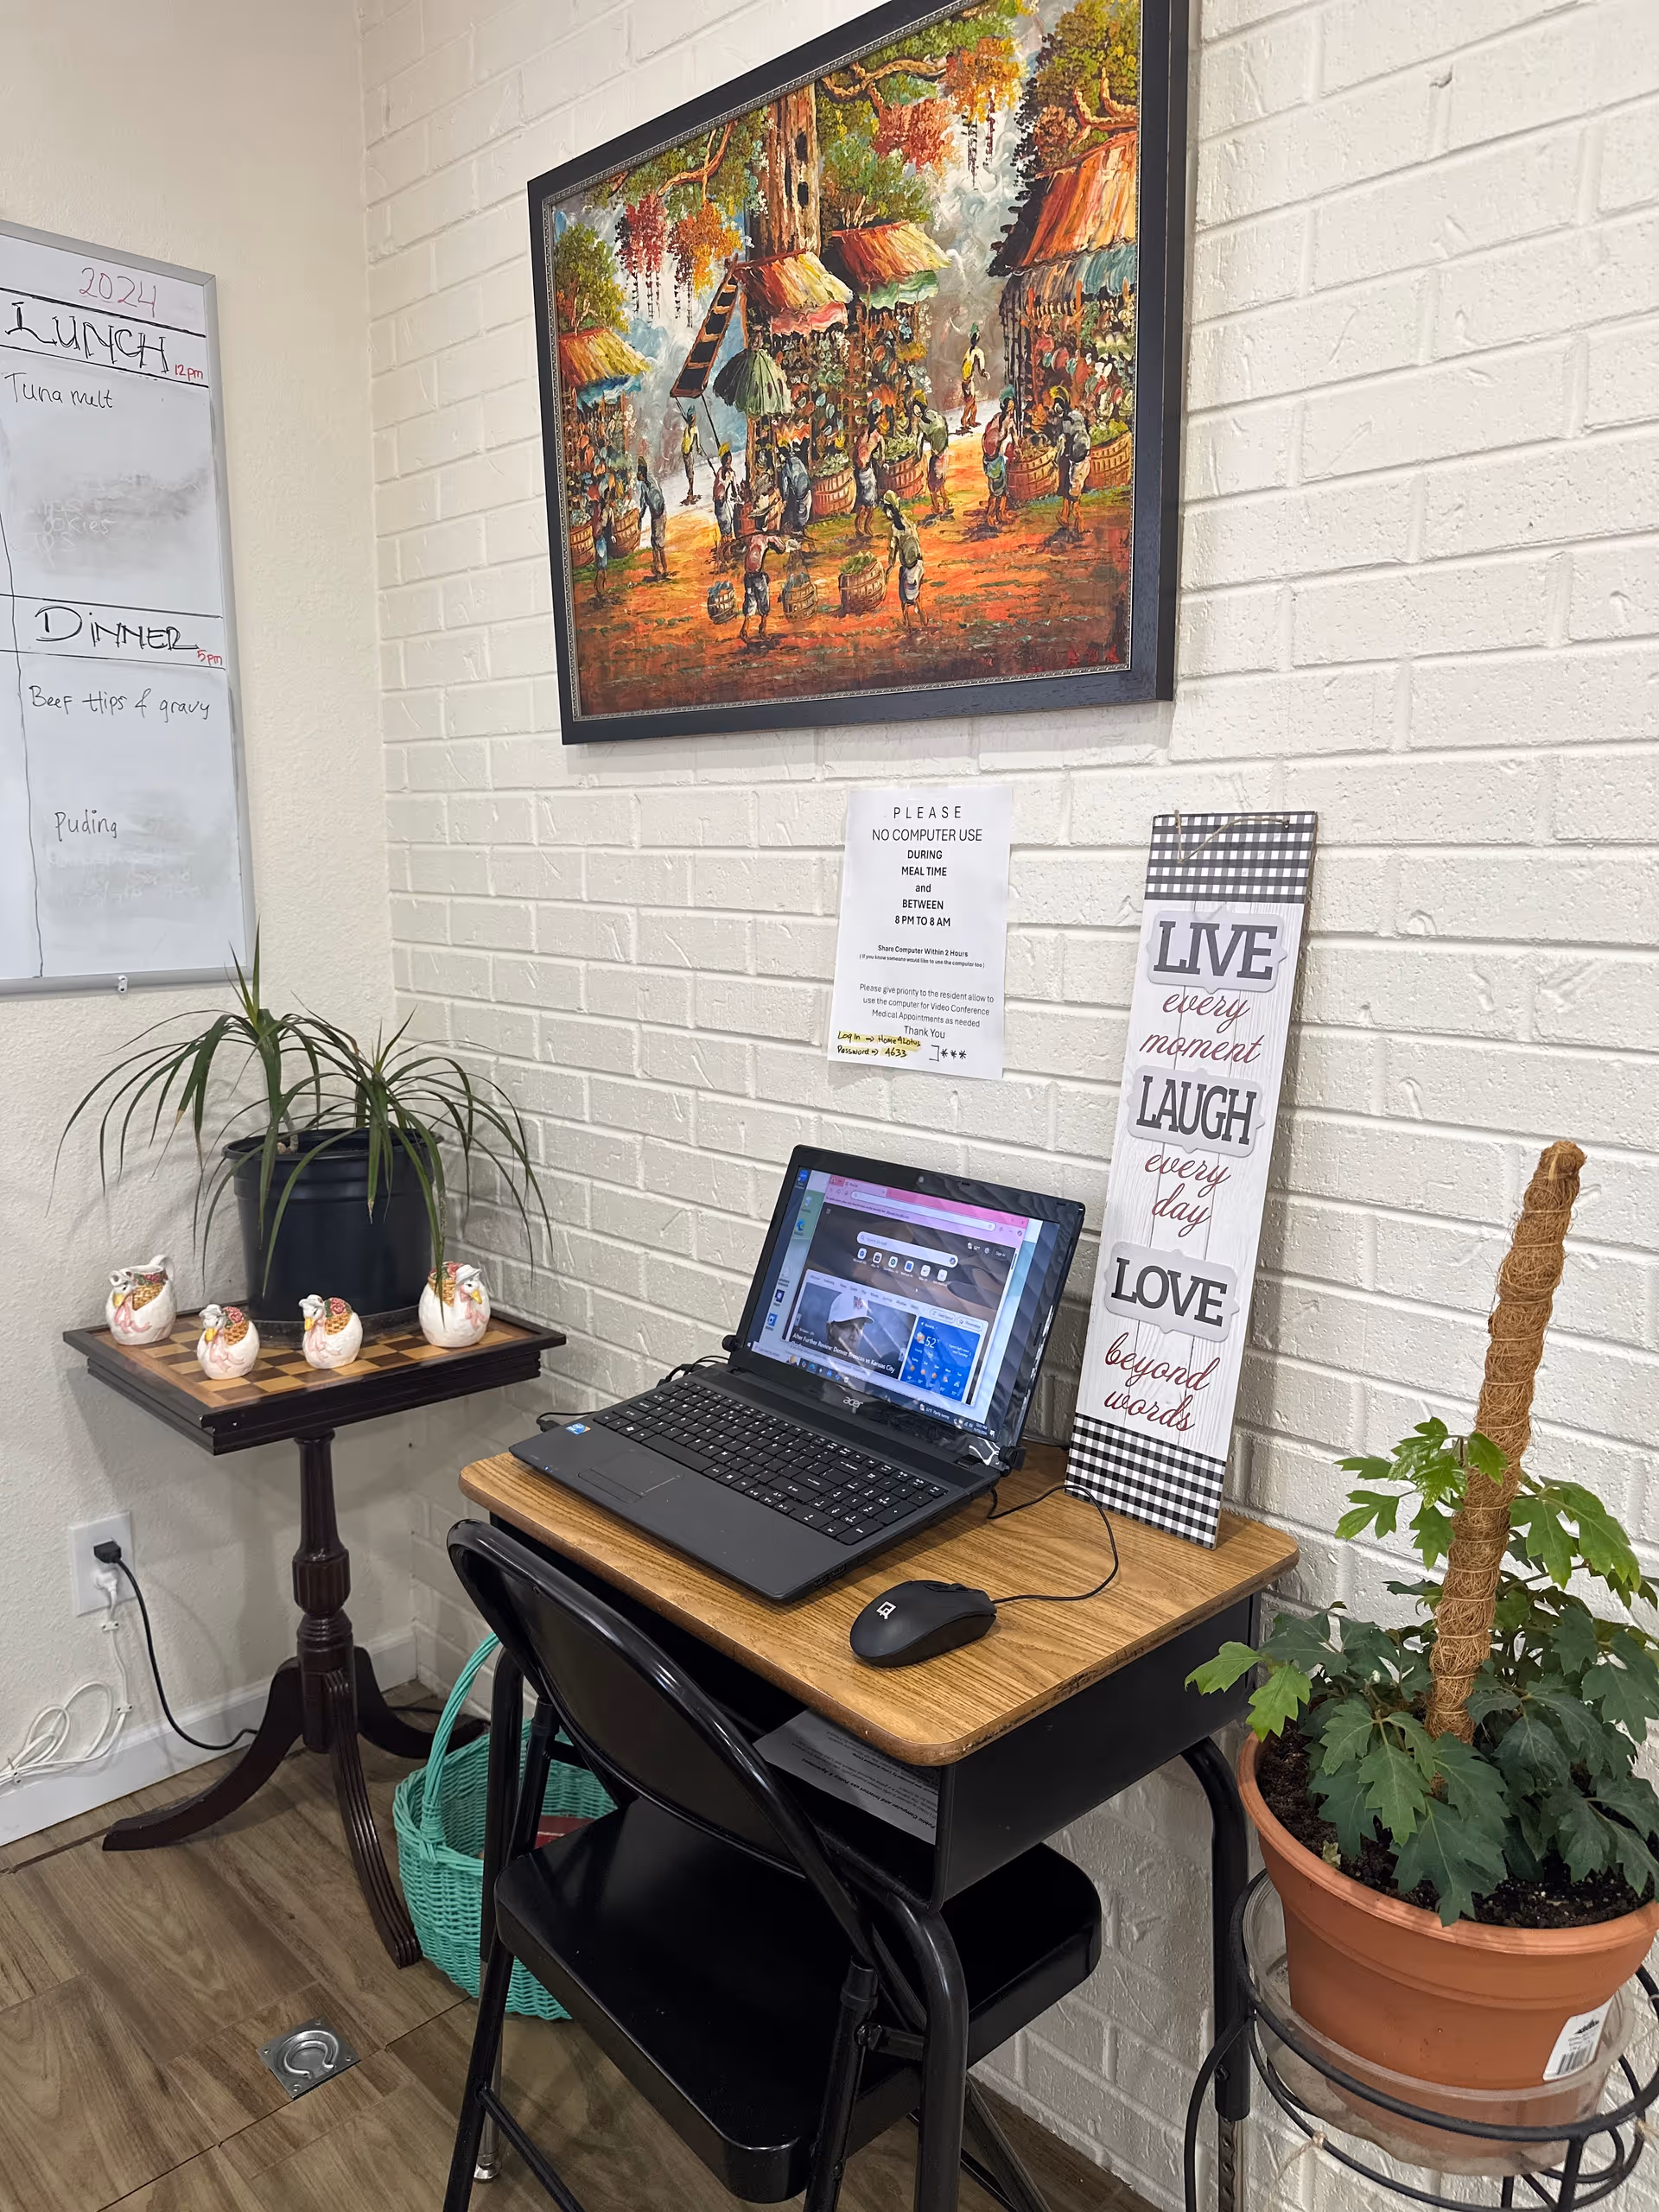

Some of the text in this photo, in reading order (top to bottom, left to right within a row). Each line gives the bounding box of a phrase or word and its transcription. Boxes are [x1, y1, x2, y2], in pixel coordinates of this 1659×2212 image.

[79, 268, 156, 317] 2024
[4, 302, 204, 382] LUNCH 12pm
[4, 372, 63, 403] Tuna
[197, 650, 224, 666] 5pm
[159, 699, 210, 723] gravy
[54, 810, 118, 842] Puding
[872, 828, 982, 842] NO COMPUTER USE
[907, 849, 943, 860] DURING
[901, 866, 947, 876] MEAL TIME
[915, 883, 931, 893] and
[902, 899, 944, 910] BETWEEN
[894, 915, 950, 927] 8 PM TO 8 AM
[878, 944, 893, 953] Share
[894, 945, 923, 955] Computer
[1154, 921, 1278, 981] LIVE
[860, 983, 994, 1003] Please give priority to the resident allow to
[862, 996, 990, 1016] use the computer for Video Conference
[1162, 994, 1250, 1033] every
[872, 1009, 898, 1019] Medical
[899, 1012, 944, 1024] Appointments
[955, 1019, 980, 1027] needed
[837, 1031, 852, 1043] Log
[904, 1025, 945, 1039] Thank You
[837, 1045, 907, 1058] Password 4633
[1139, 1034, 1264, 1064] moment
[1136, 1075, 1257, 1145] LAUGH
[1144, 1154, 1231, 1198] every
[1151, 1183, 1211, 1237] day
[1111, 1257, 1228, 1327] LOVE
[792, 1332, 804, 1342] After
[804, 1335, 818, 1346] Further
[833, 1343, 848, 1356] Denver
[871, 1357, 887, 1370] Kansas
[886, 1364, 895, 1374] City
[1104, 1332, 1221, 1391] beyond
[842, 1396, 863, 1408] acer
[1103, 1390, 1195, 1432] words
